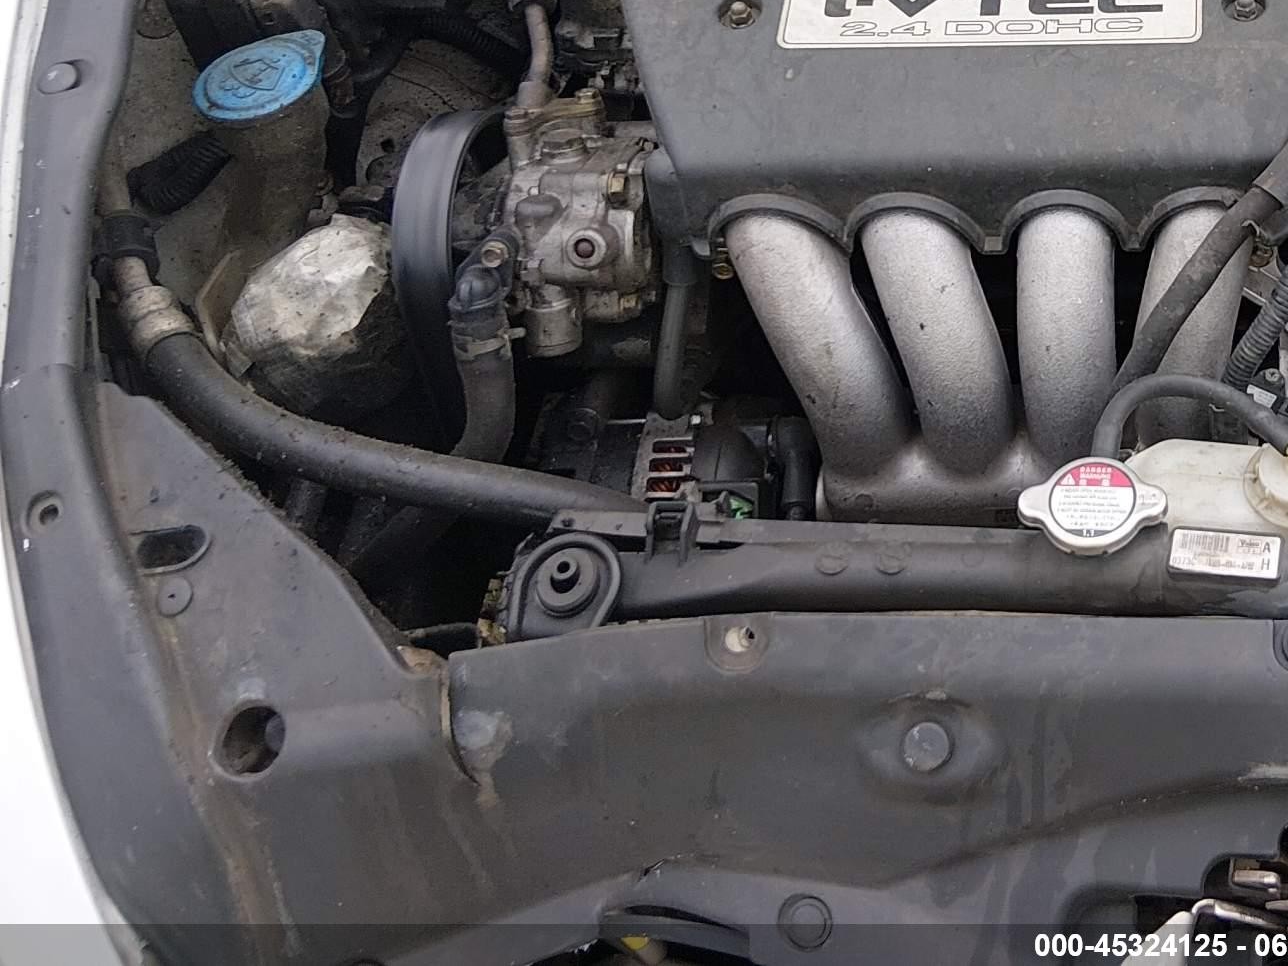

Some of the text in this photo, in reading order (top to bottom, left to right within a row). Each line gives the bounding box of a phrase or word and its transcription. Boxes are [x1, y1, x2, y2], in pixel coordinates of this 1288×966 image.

[840, 17, 1144, 37] 2.4 DOHC
[1263, 542, 1271, 553] A
[1261, 558, 1270, 571] H
